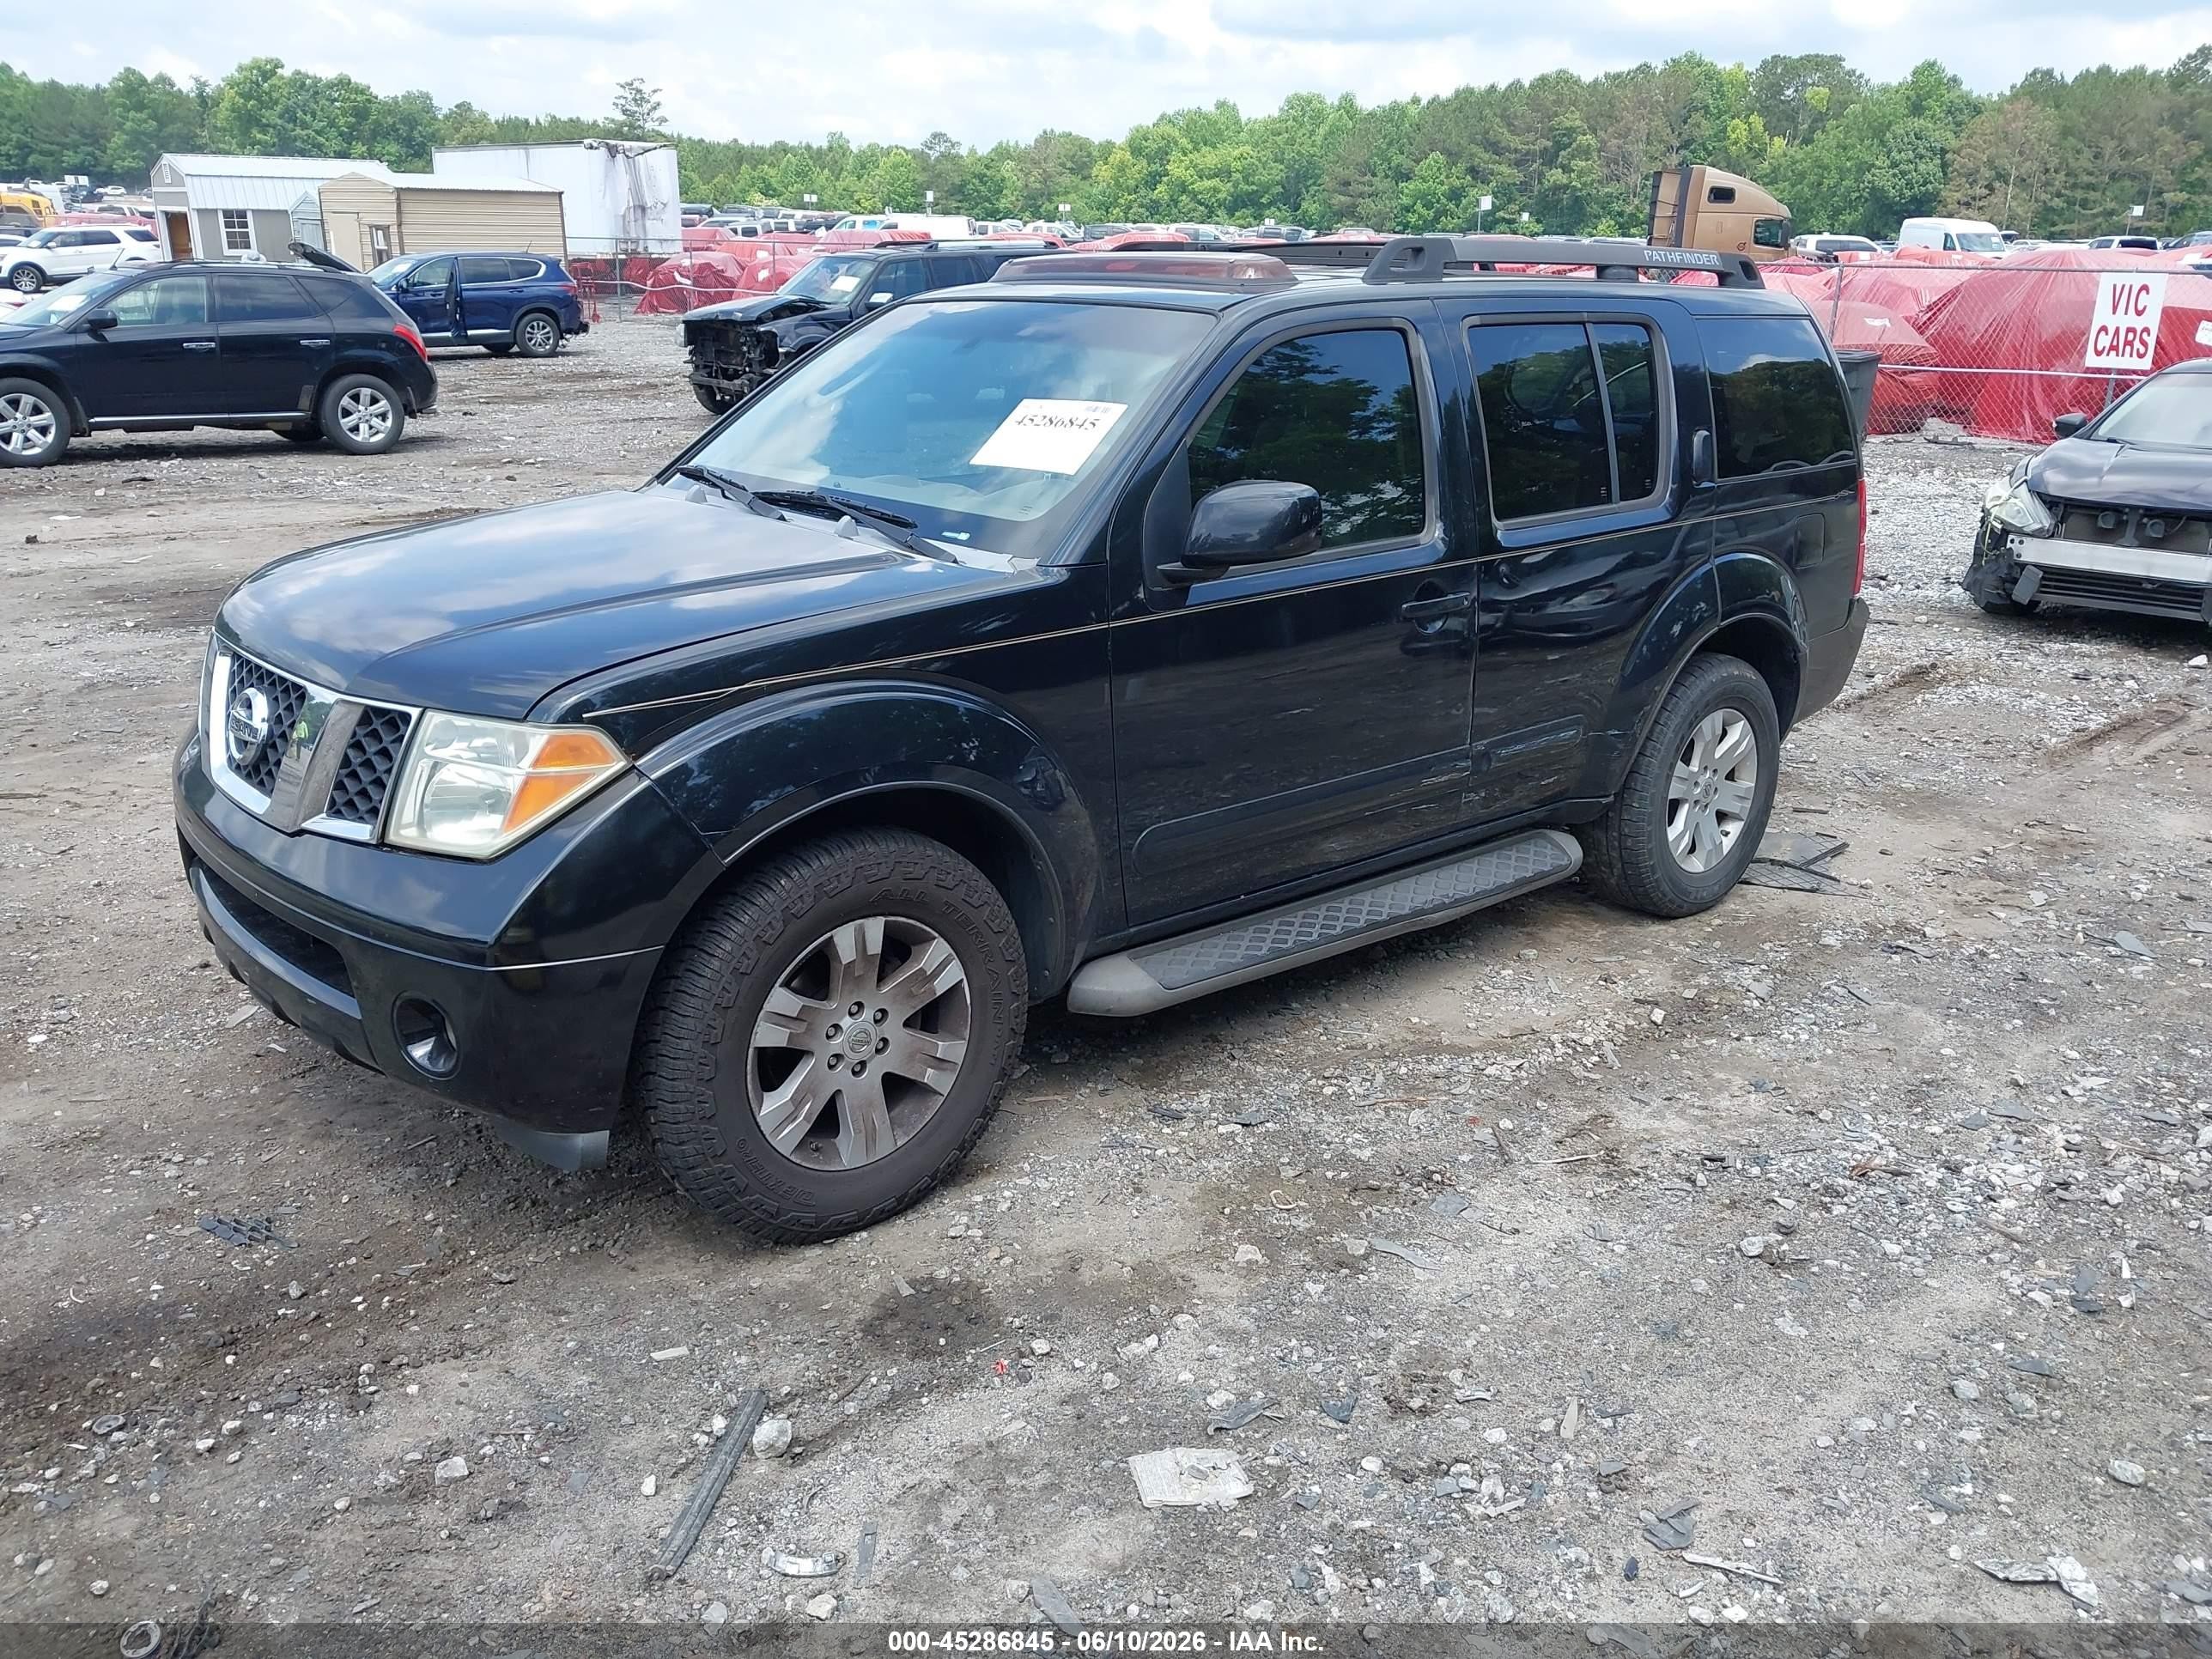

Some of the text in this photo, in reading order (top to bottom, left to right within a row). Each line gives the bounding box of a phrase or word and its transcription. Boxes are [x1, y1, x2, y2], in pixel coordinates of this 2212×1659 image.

[1644, 250, 1719, 265] PATHFINDER
[2112, 283, 2150, 316] VIC
[2094, 325, 2151, 359] CARS
[1015, 414, 1100, 431] 45286845
